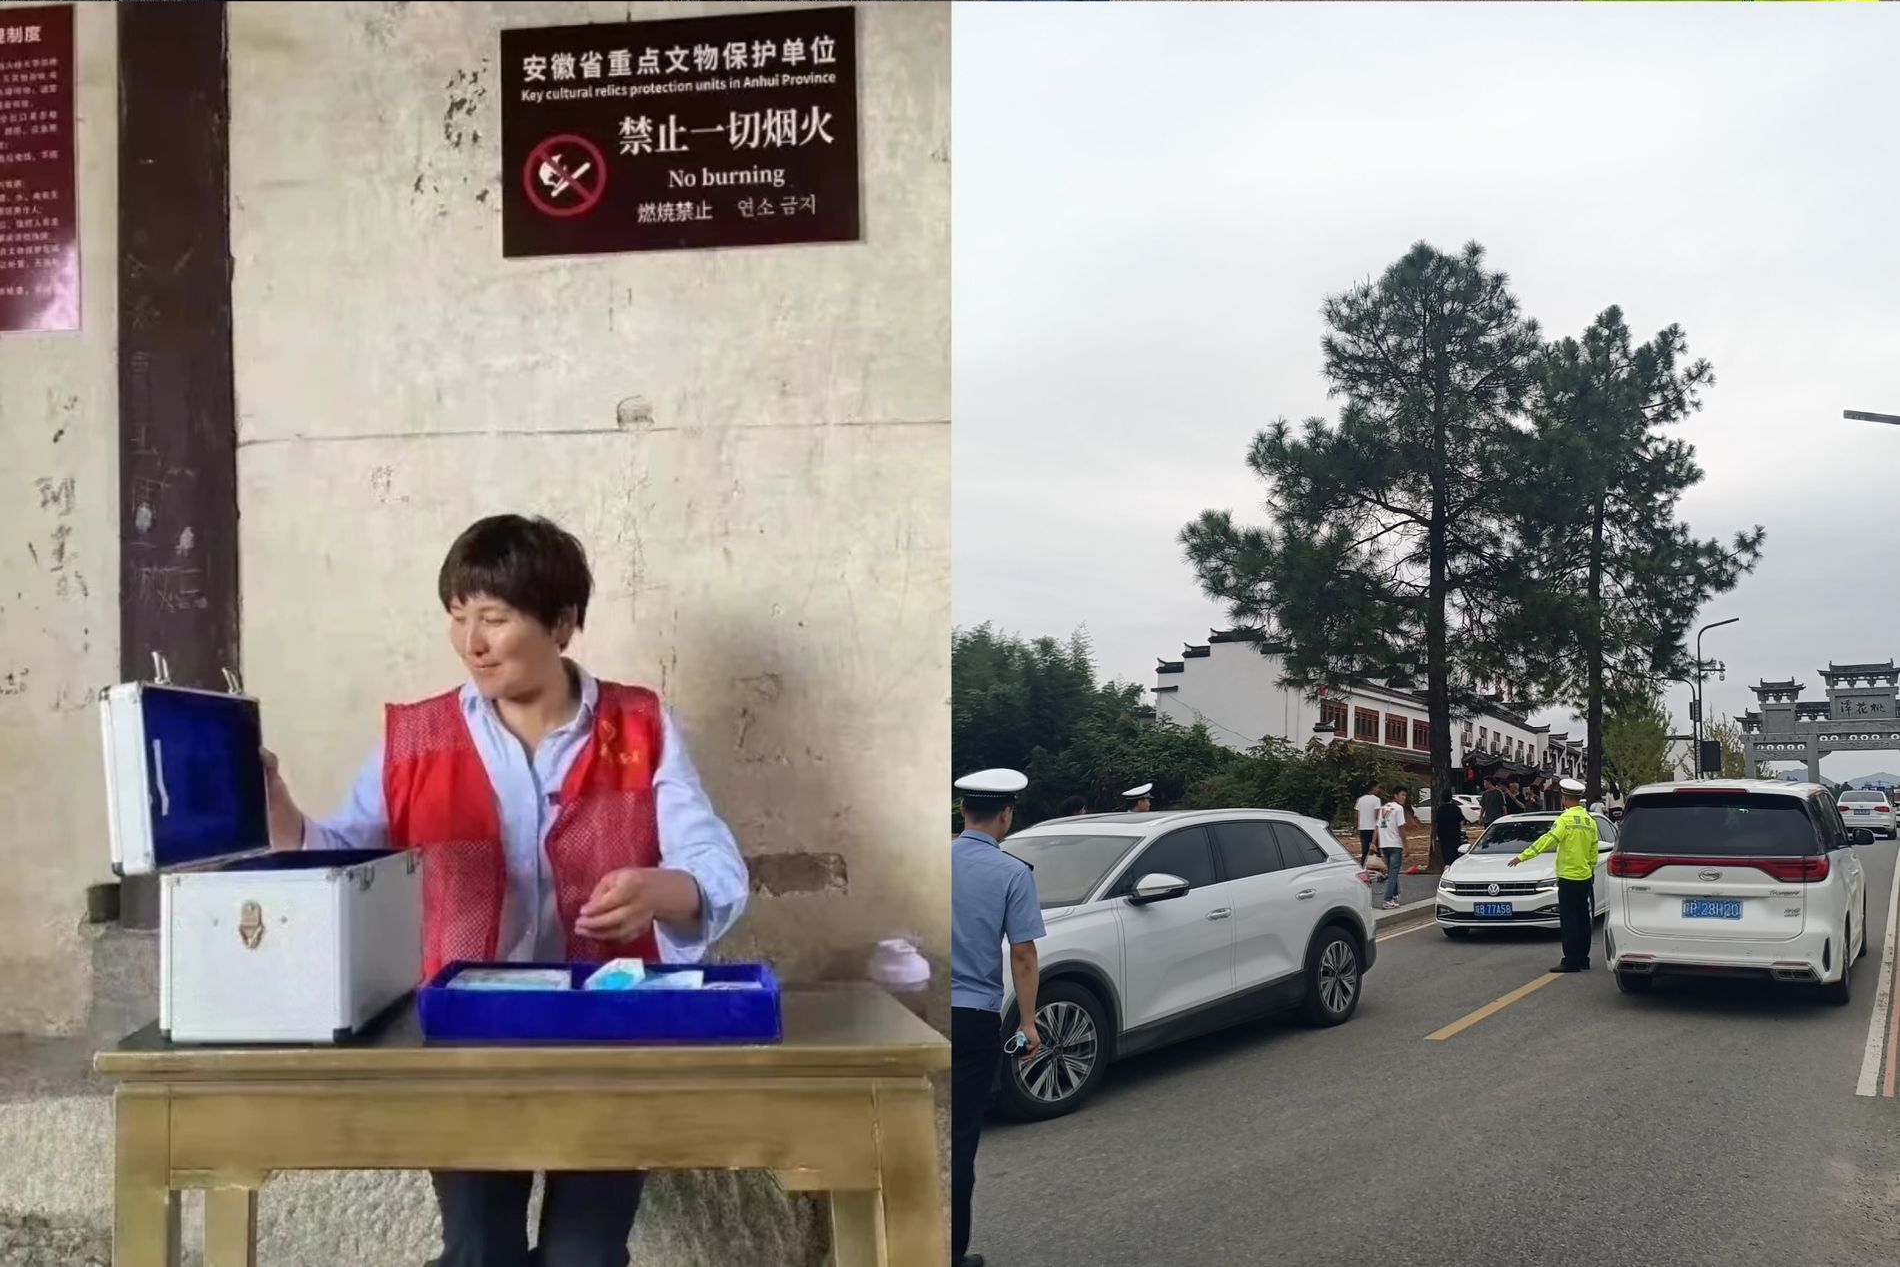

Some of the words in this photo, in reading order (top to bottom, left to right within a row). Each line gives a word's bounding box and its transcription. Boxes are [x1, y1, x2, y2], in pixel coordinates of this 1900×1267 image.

[522, 35, 837, 83] 安徽省重点文物保护单位
[521, 89, 545, 104] Key
[545, 85, 594, 101] cultural
[595, 83, 628, 98] relics
[629, 79, 693, 98] protection
[696, 76, 727, 92] units
[729, 76, 741, 89] in
[743, 73, 780, 88] Anhui
[782, 70, 837, 86] Province
[618, 105, 835, 156] 禁止一切烟火
[668, 169, 697, 188] No
[701, 164, 786, 188] burning
[737, 197, 775, 218] 연소
[779, 193, 816, 216] 금지
